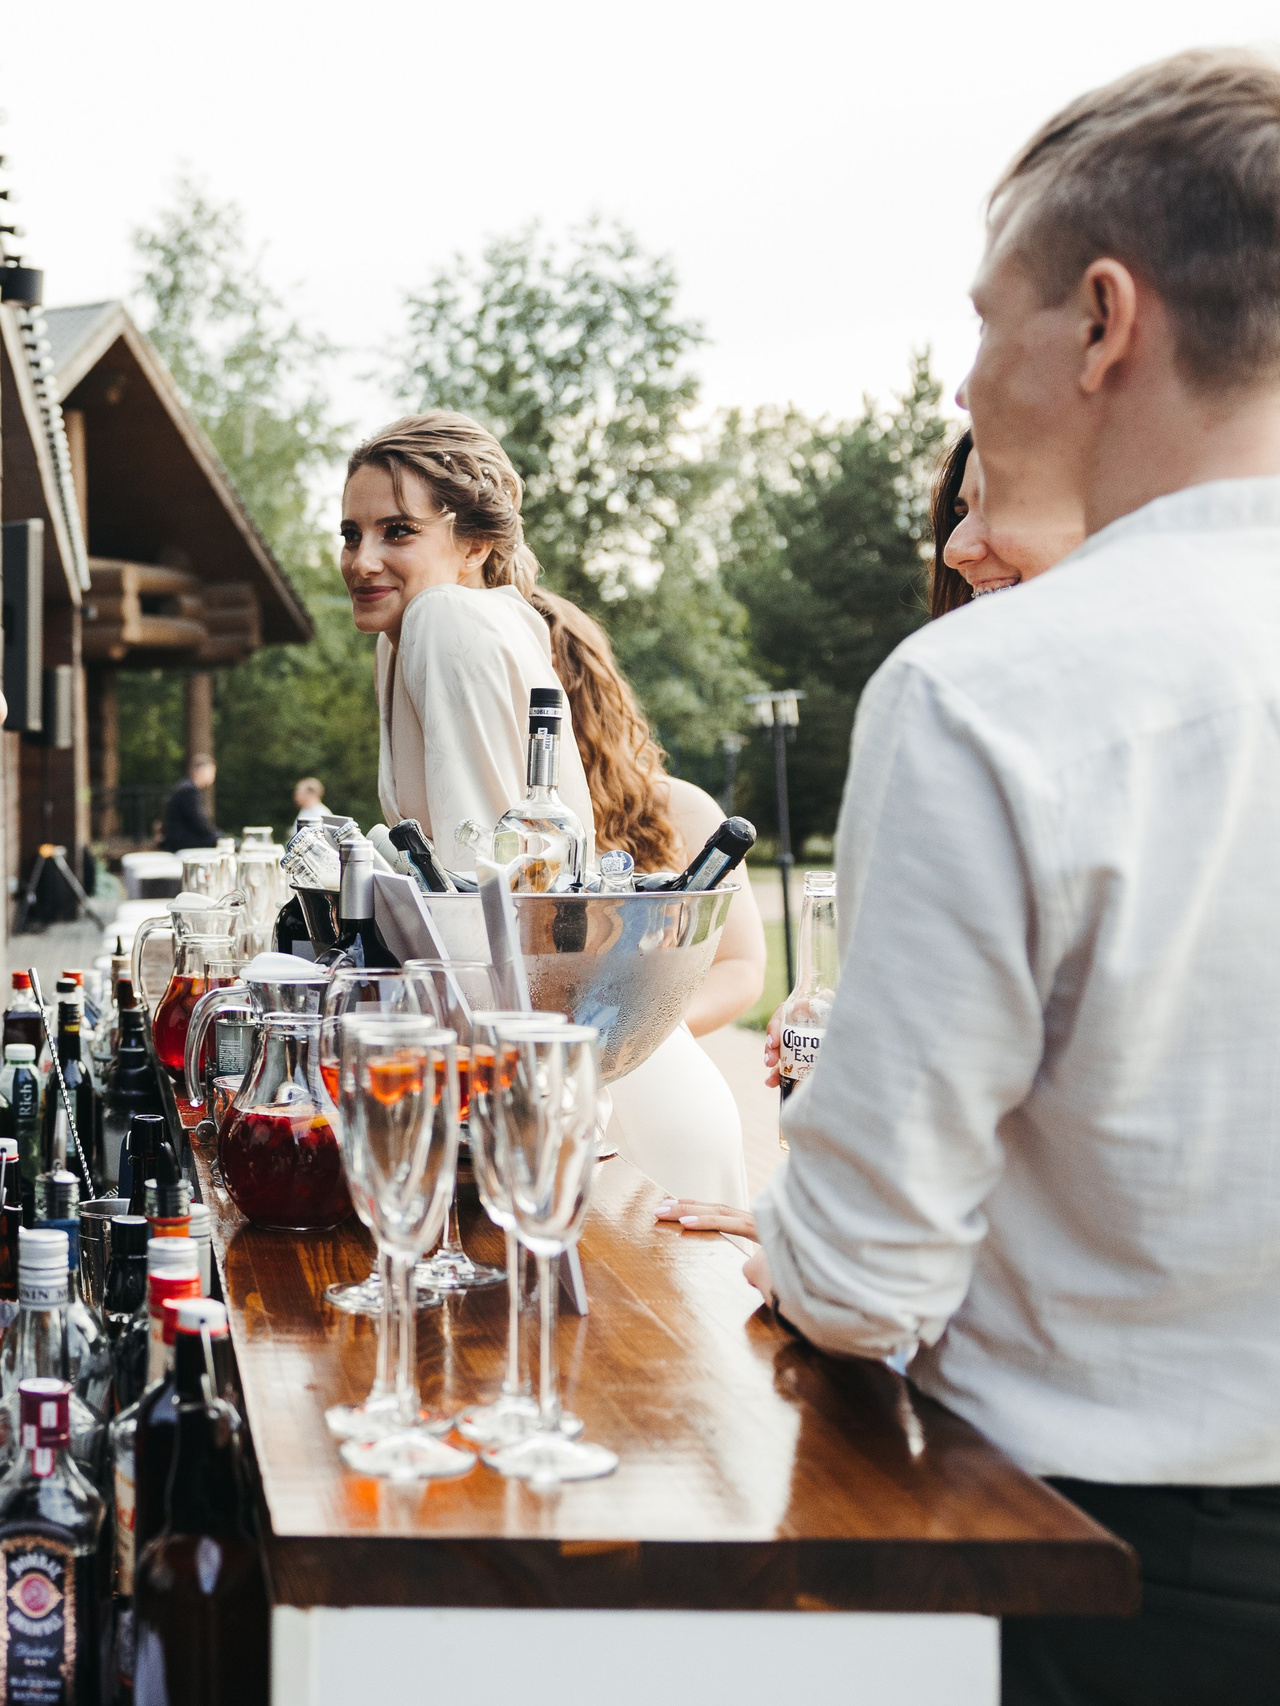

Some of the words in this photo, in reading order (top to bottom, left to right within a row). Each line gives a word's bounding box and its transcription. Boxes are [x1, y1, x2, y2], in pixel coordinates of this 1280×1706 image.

[782, 1028, 821, 1052] Coro
[794, 1048, 815, 1063] Ext
[19, 1083, 33, 1116] Rich
